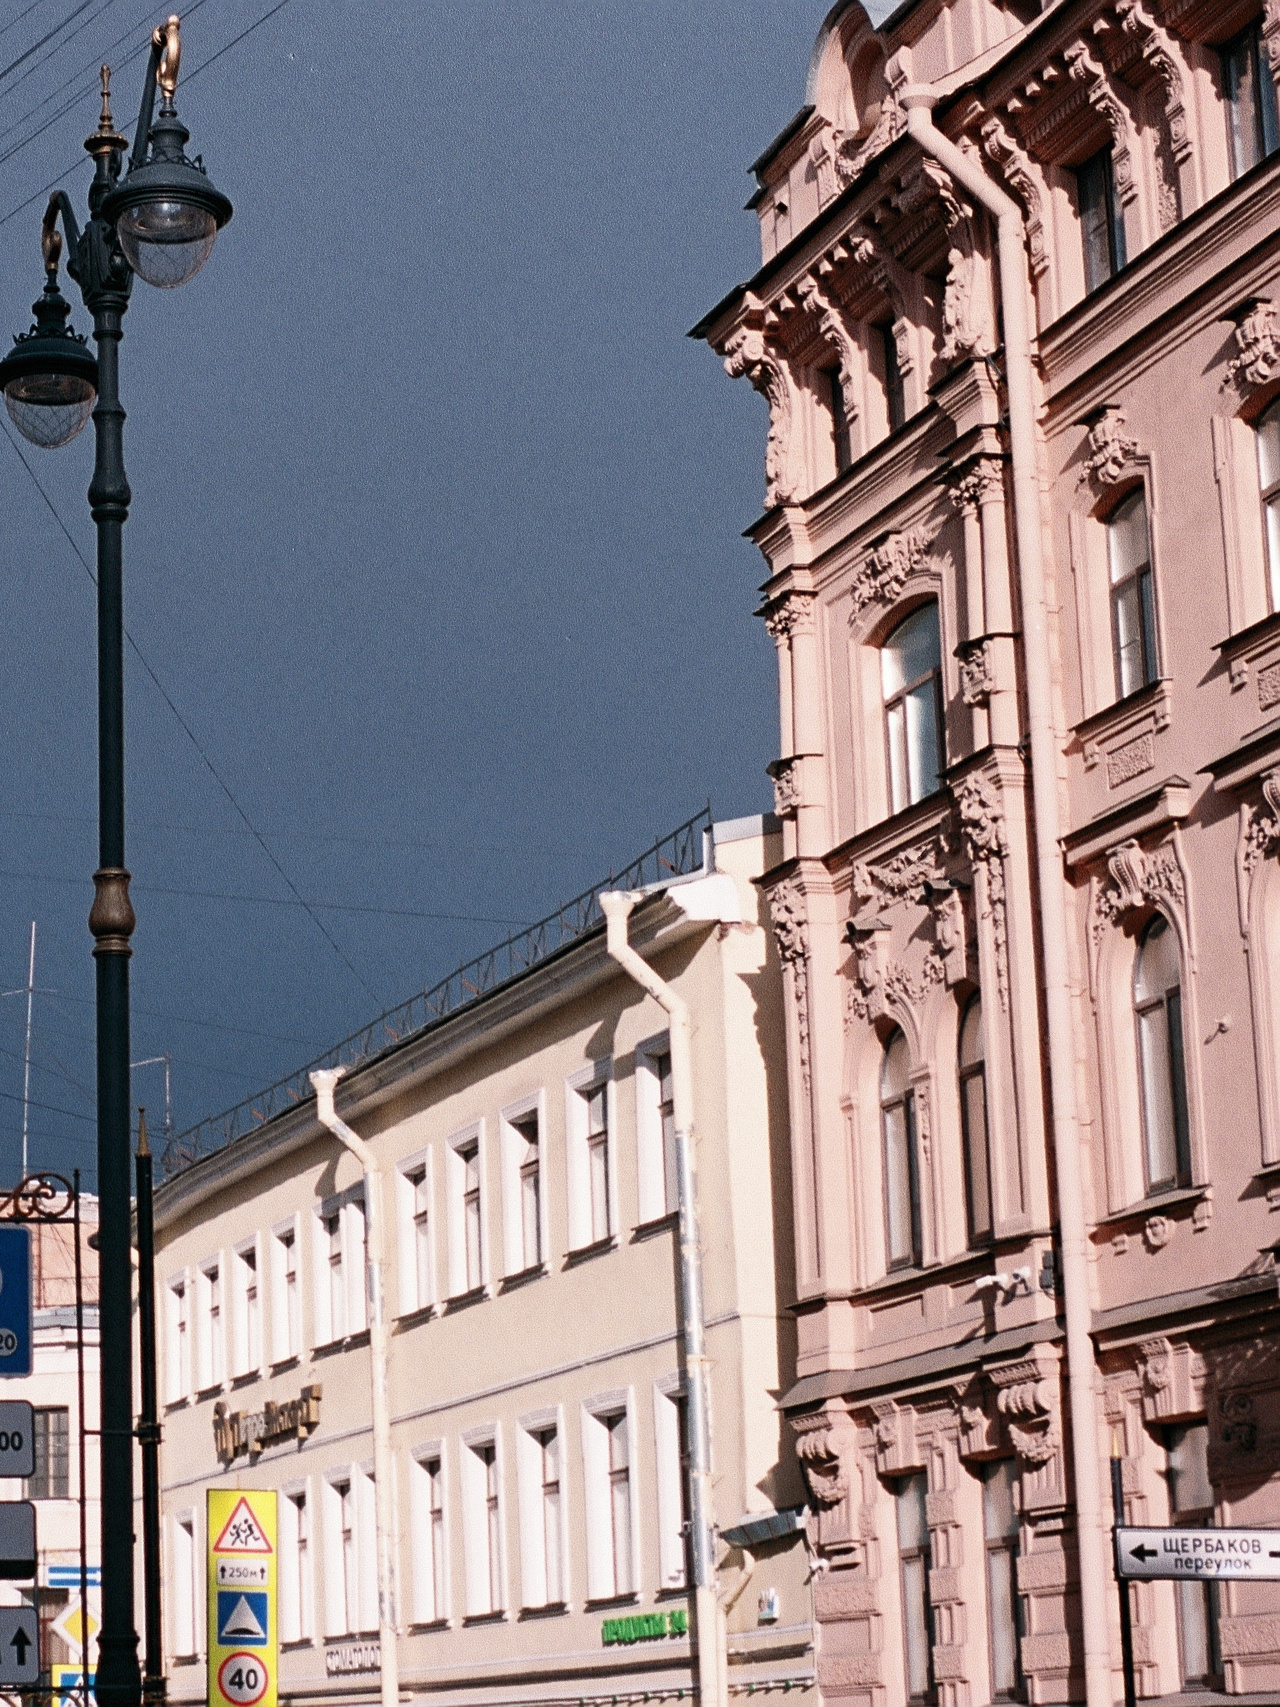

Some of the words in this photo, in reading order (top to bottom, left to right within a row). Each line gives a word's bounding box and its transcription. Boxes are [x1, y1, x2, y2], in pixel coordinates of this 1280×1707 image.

[1162, 1537, 1262, 1554] ЩЕРБАКОВ
[1174, 1557, 1252, 1573] переулок
[228, 1668, 258, 1690] 40
